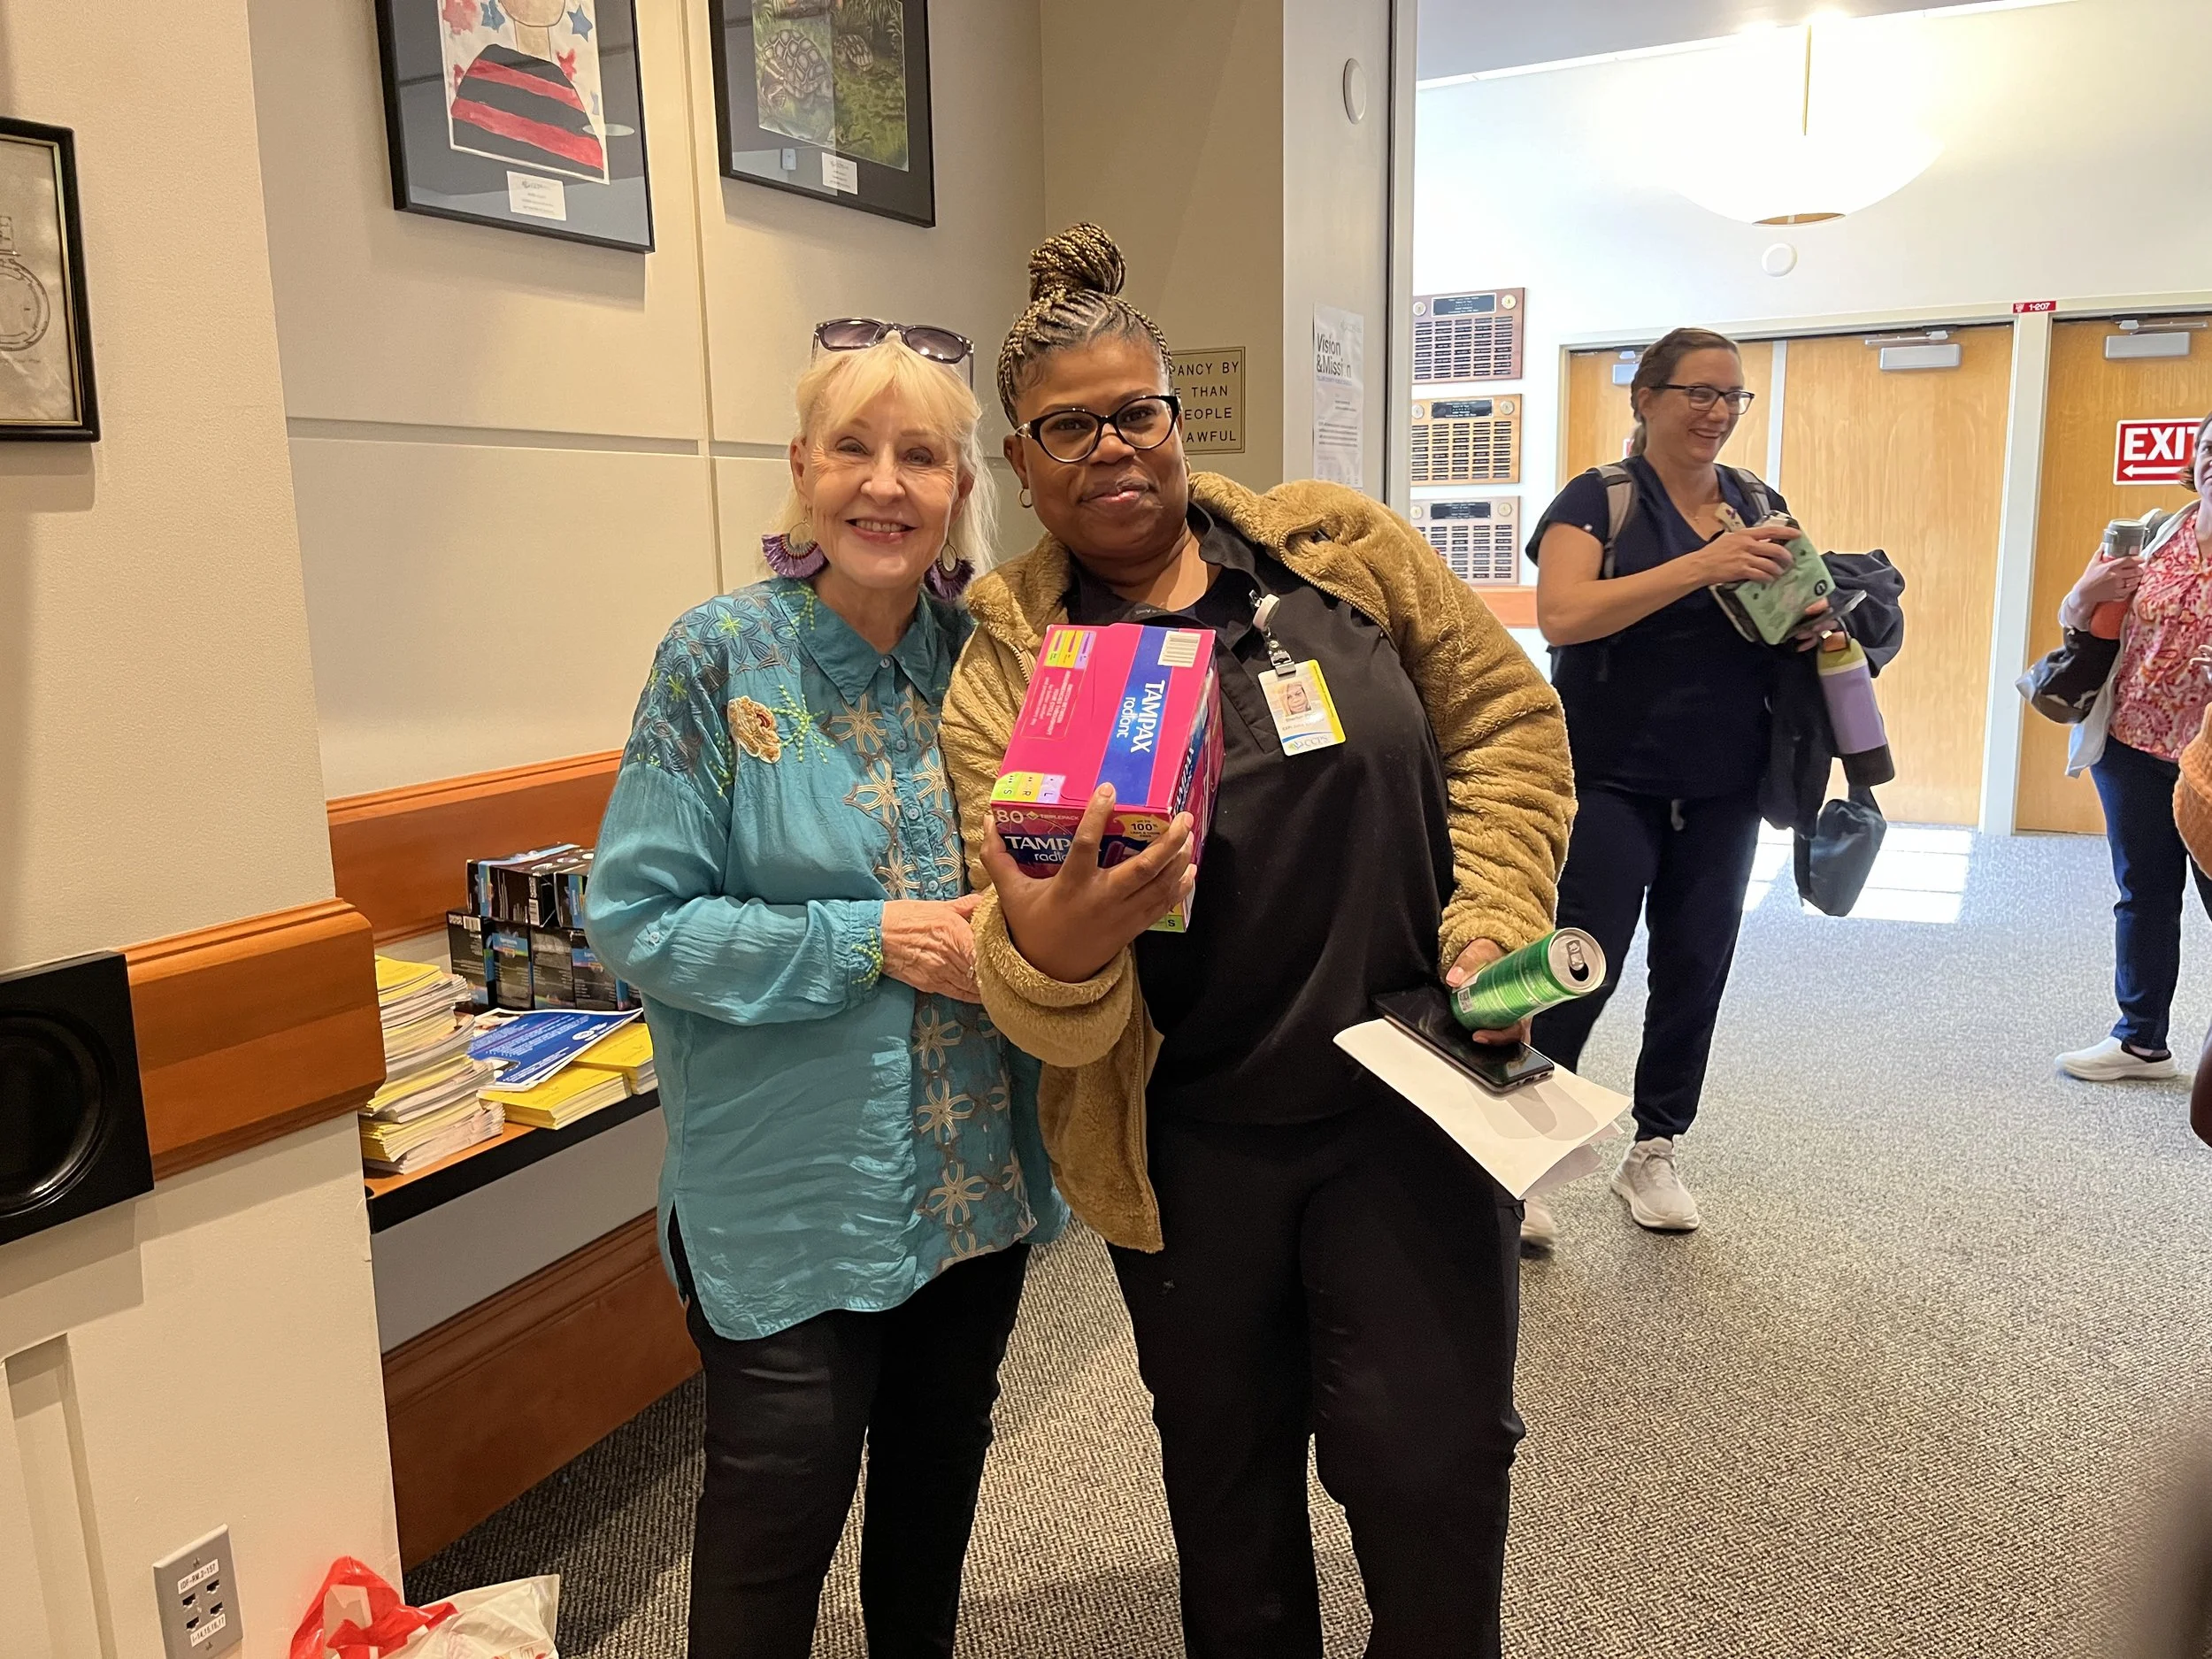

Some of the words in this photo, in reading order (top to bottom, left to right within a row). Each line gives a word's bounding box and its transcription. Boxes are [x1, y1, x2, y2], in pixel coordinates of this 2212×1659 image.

[2029, 302, 2051, 311] 1-207
[1317, 333, 1341, 356] Vision
[1169, 362, 1212, 376] PANCY
[1222, 361, 1239, 373] BY
[1317, 354, 1352, 378] &Missin
[1191, 385, 1228, 397] THAN
[1184, 407, 1233, 419] EOPLE
[1182, 430, 1237, 443] AWFUL
[1116, 696, 1138, 738] radiant
[1130, 680, 1165, 753] TAMPAX
[996, 810, 1024, 824] 80
[1004, 835, 1072, 851] TAMP
